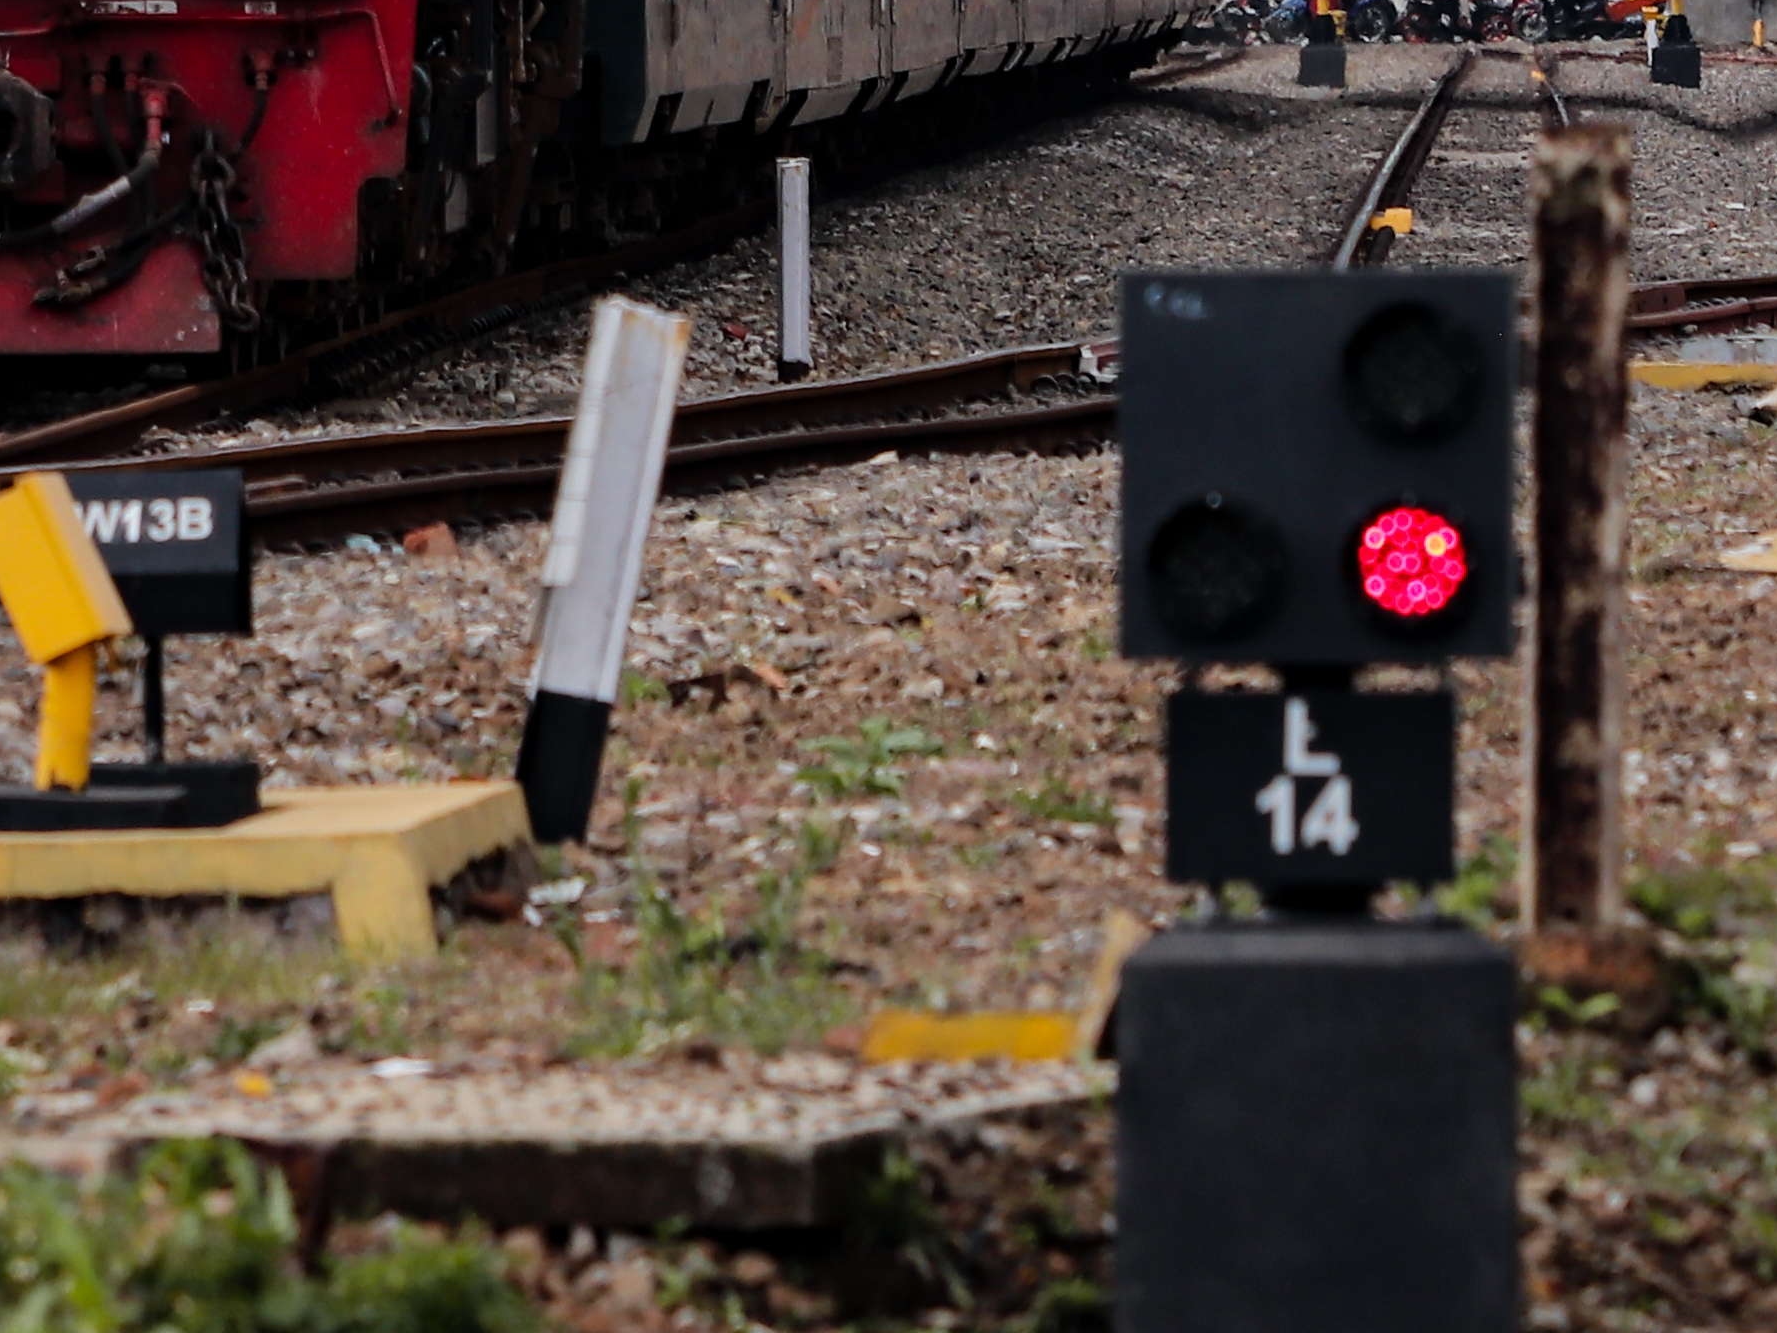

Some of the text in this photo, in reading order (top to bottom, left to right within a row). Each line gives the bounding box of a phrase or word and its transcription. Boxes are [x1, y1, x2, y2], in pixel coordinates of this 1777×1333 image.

[72, 496, 214, 544] W13B
[1283, 696, 1342, 776] L
[1254, 773, 1361, 856] 14
